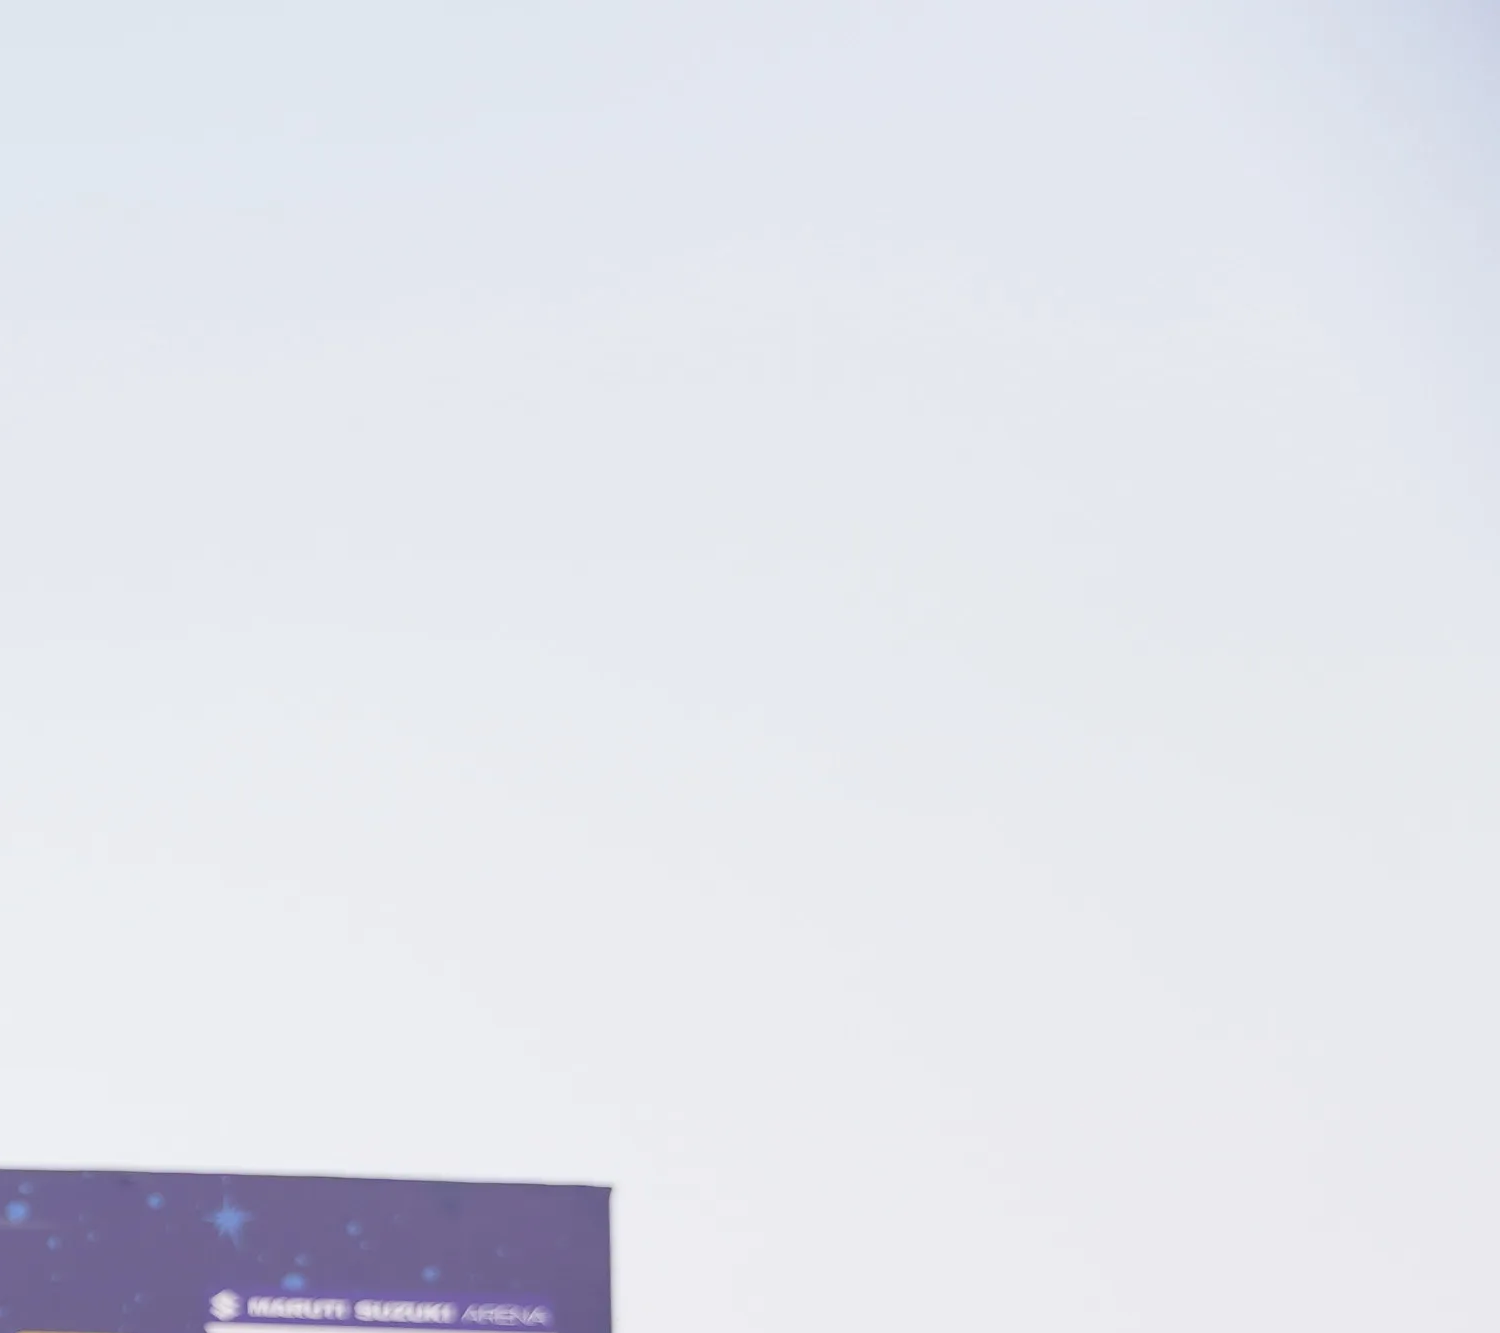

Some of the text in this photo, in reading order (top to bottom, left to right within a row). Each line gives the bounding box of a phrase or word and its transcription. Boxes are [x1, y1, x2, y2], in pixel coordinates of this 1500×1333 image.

[247, 1296, 551, 1327] MARUTI SUZUKI ARENA
